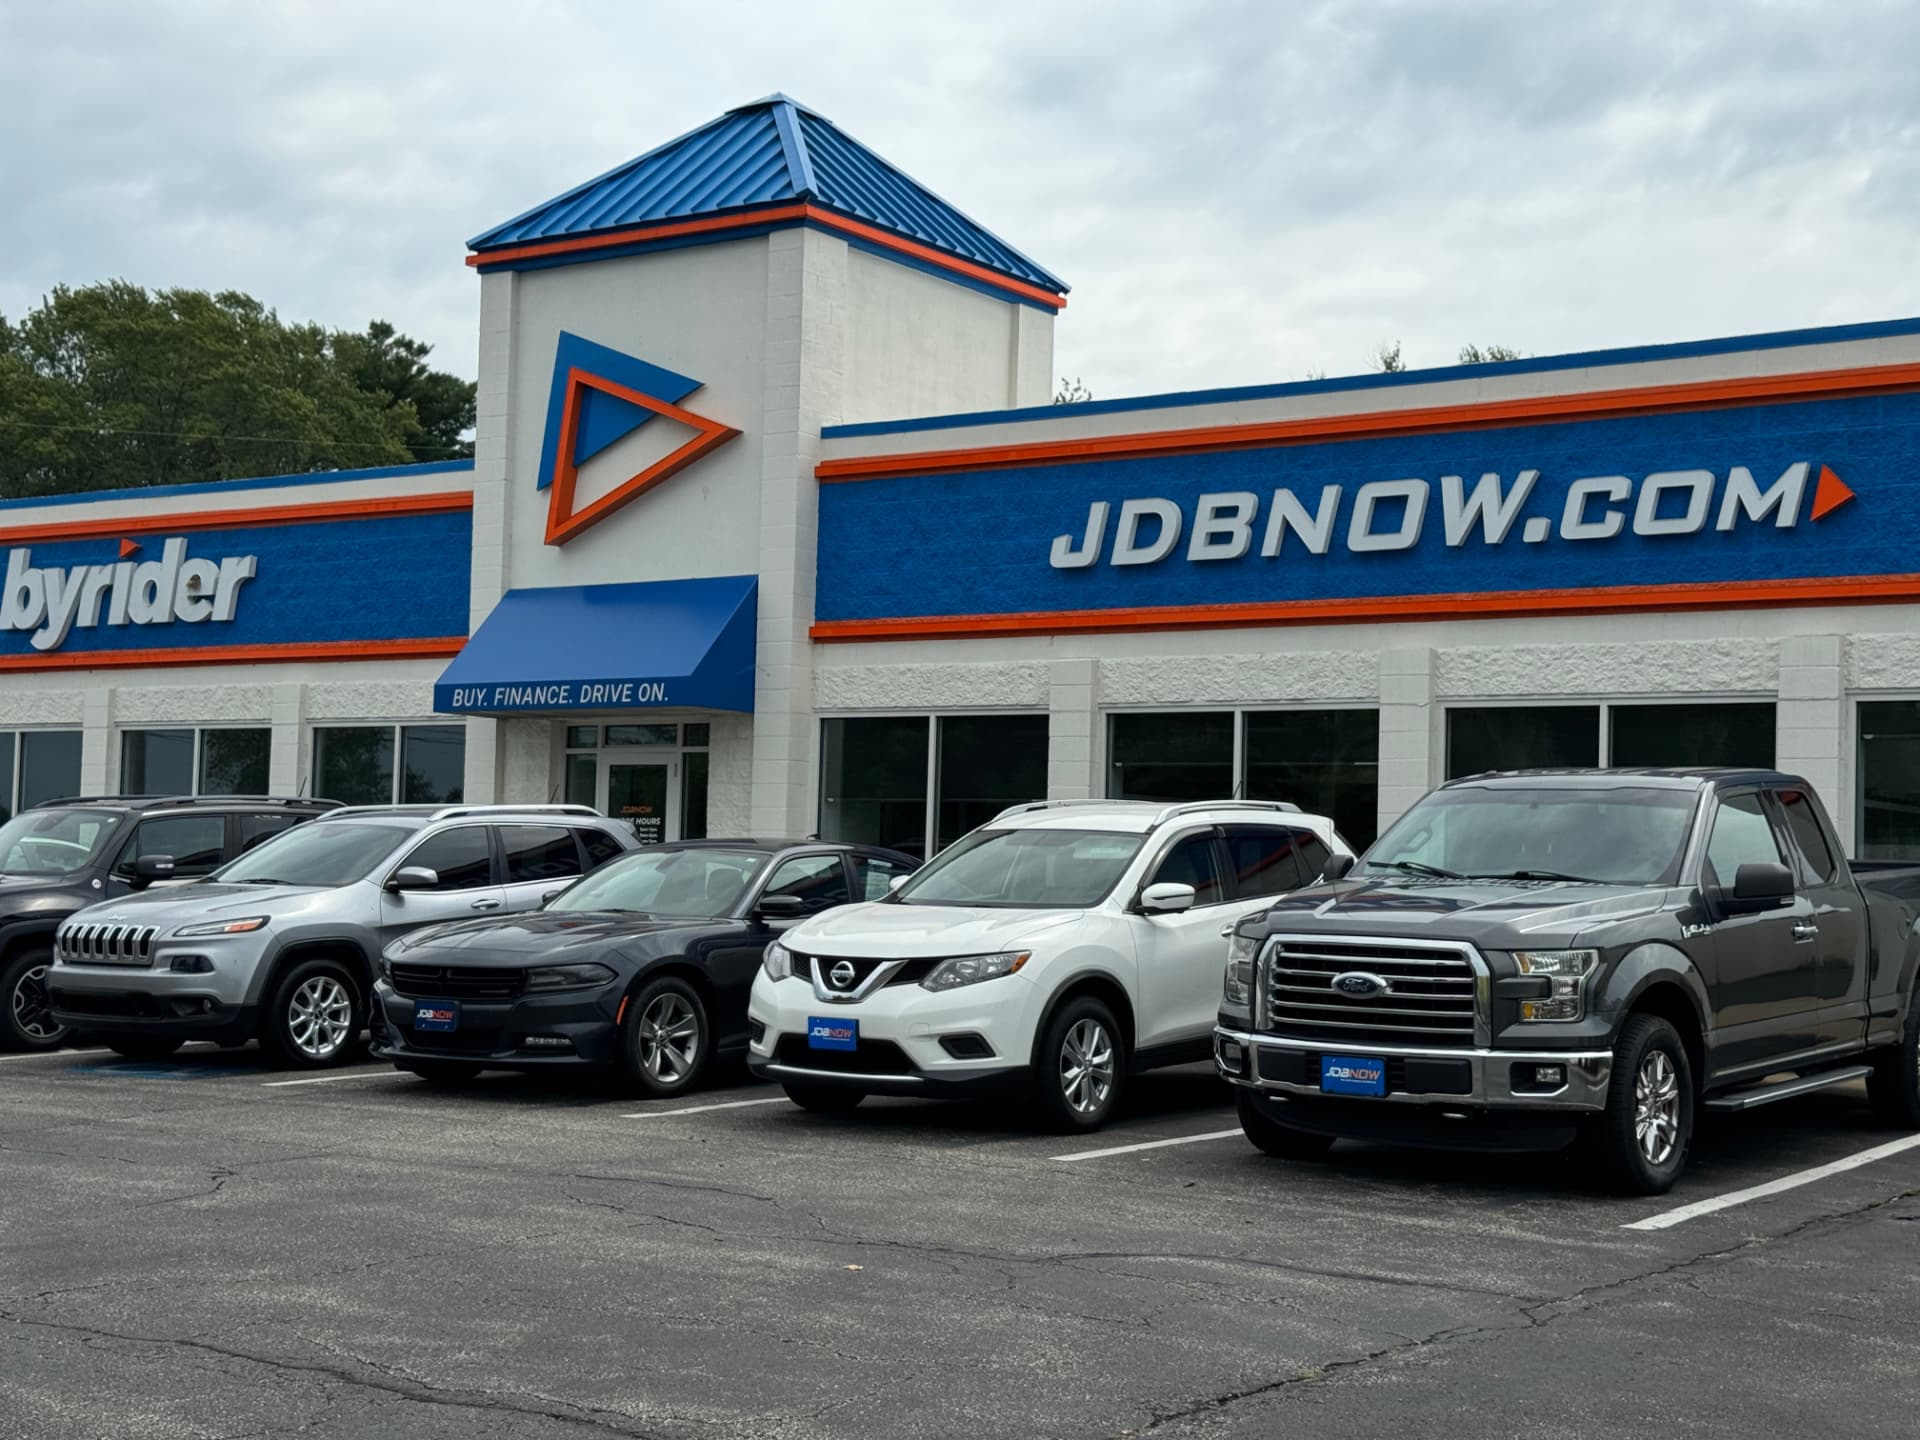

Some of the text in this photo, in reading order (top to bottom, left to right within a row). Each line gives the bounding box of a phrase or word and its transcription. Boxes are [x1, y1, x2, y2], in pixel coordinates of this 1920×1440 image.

[1049, 461, 1810, 570] JDBNOW.COM
[0, 536, 258, 651] byrider
[451, 682, 669, 707] BUY. FINANCE. DRIVE ON.
[635, 817, 661, 825] HOURS
[1325, 1066, 1381, 1081] JDBNOW
